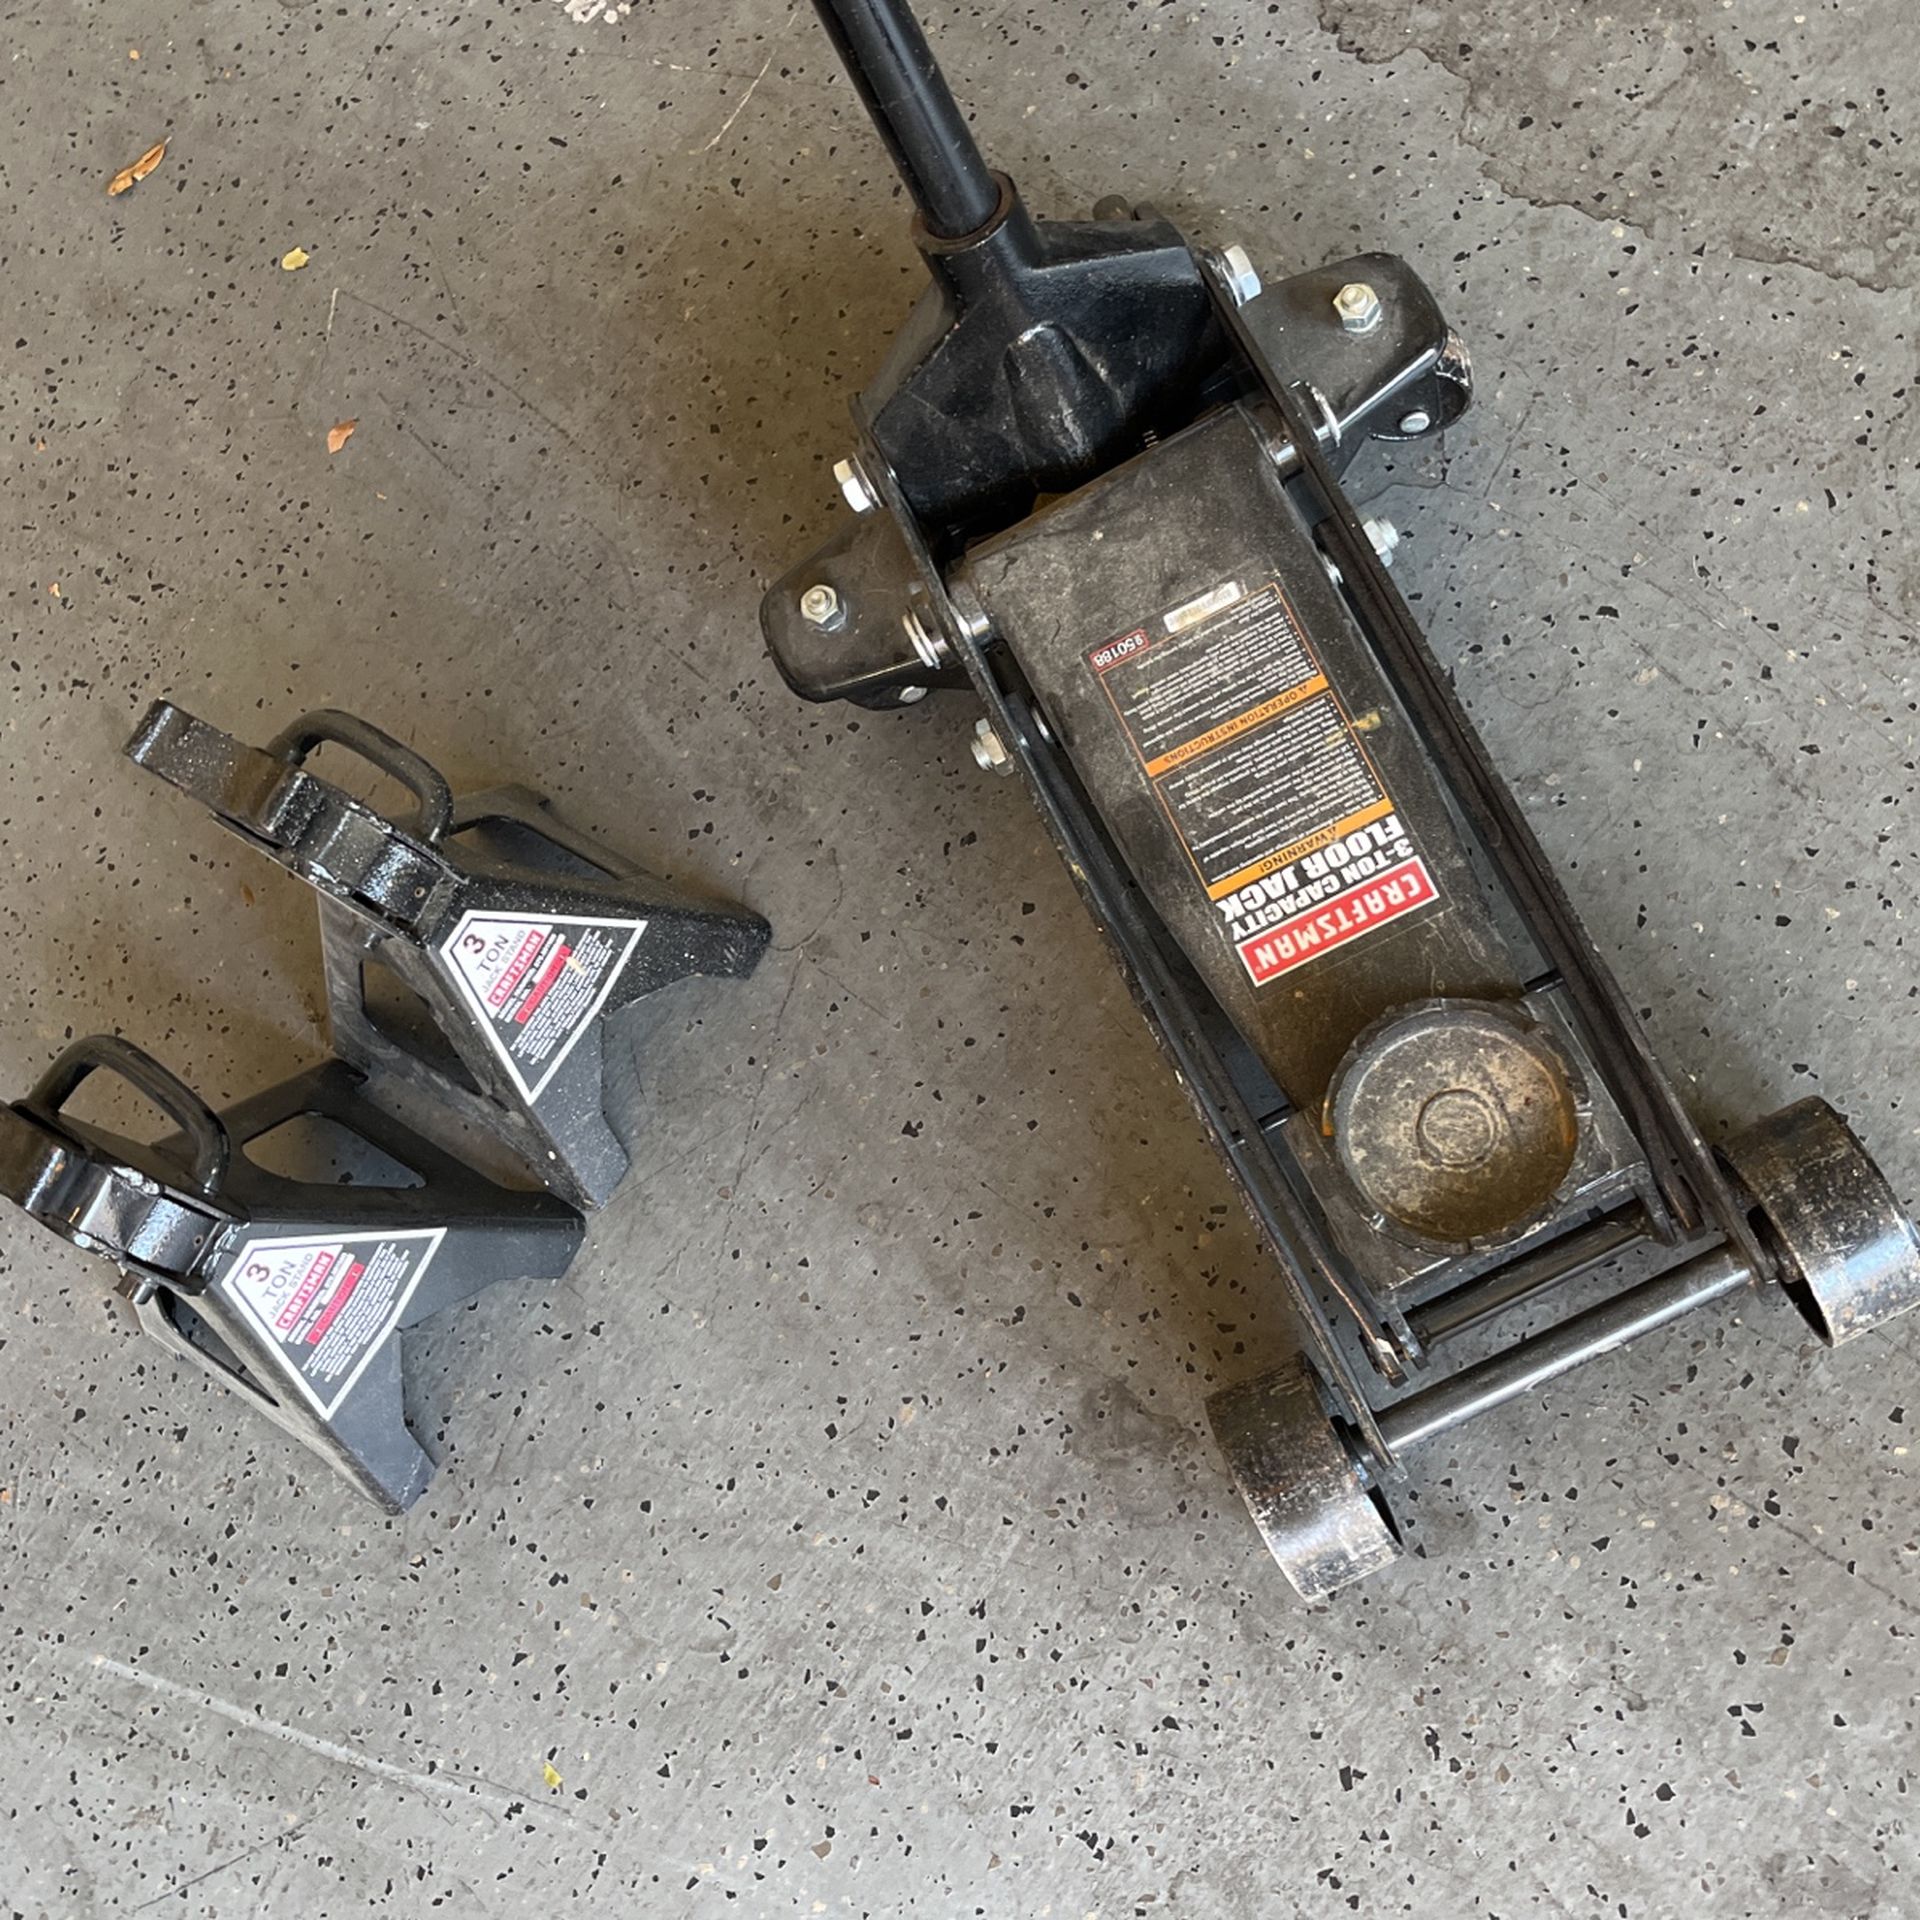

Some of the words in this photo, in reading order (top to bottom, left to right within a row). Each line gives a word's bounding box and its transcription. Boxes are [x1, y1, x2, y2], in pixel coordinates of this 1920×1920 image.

[1094, 633, 1144, 667] 950188
[1239, 692, 1298, 724] OPERATION
[1164, 719, 1238, 763] INSTRUCTIONS
[1260, 833, 1326, 873] WARNING!
[1301, 814, 1405, 880] FLOOR
[1340, 837, 1414, 884] 3-TON
[1215, 865, 1299, 923] JACK
[1231, 875, 1341, 941] CAPACITY
[463, 934, 486, 954] 3
[1253, 873, 1422, 971] CRAFTSMAN
[476, 935, 509, 971] TON
[482, 966, 502, 993] JACK
[501, 930, 526, 964] STAND
[490, 932, 542, 1004] CRAFTSMAN
[246, 1263, 270, 1283] 3
[262, 1260, 296, 1298] TON
[269, 1291, 291, 1319] JACK
[289, 1253, 313, 1288] STAND
[277, 1253, 331, 1328] CRAFTSMAN
